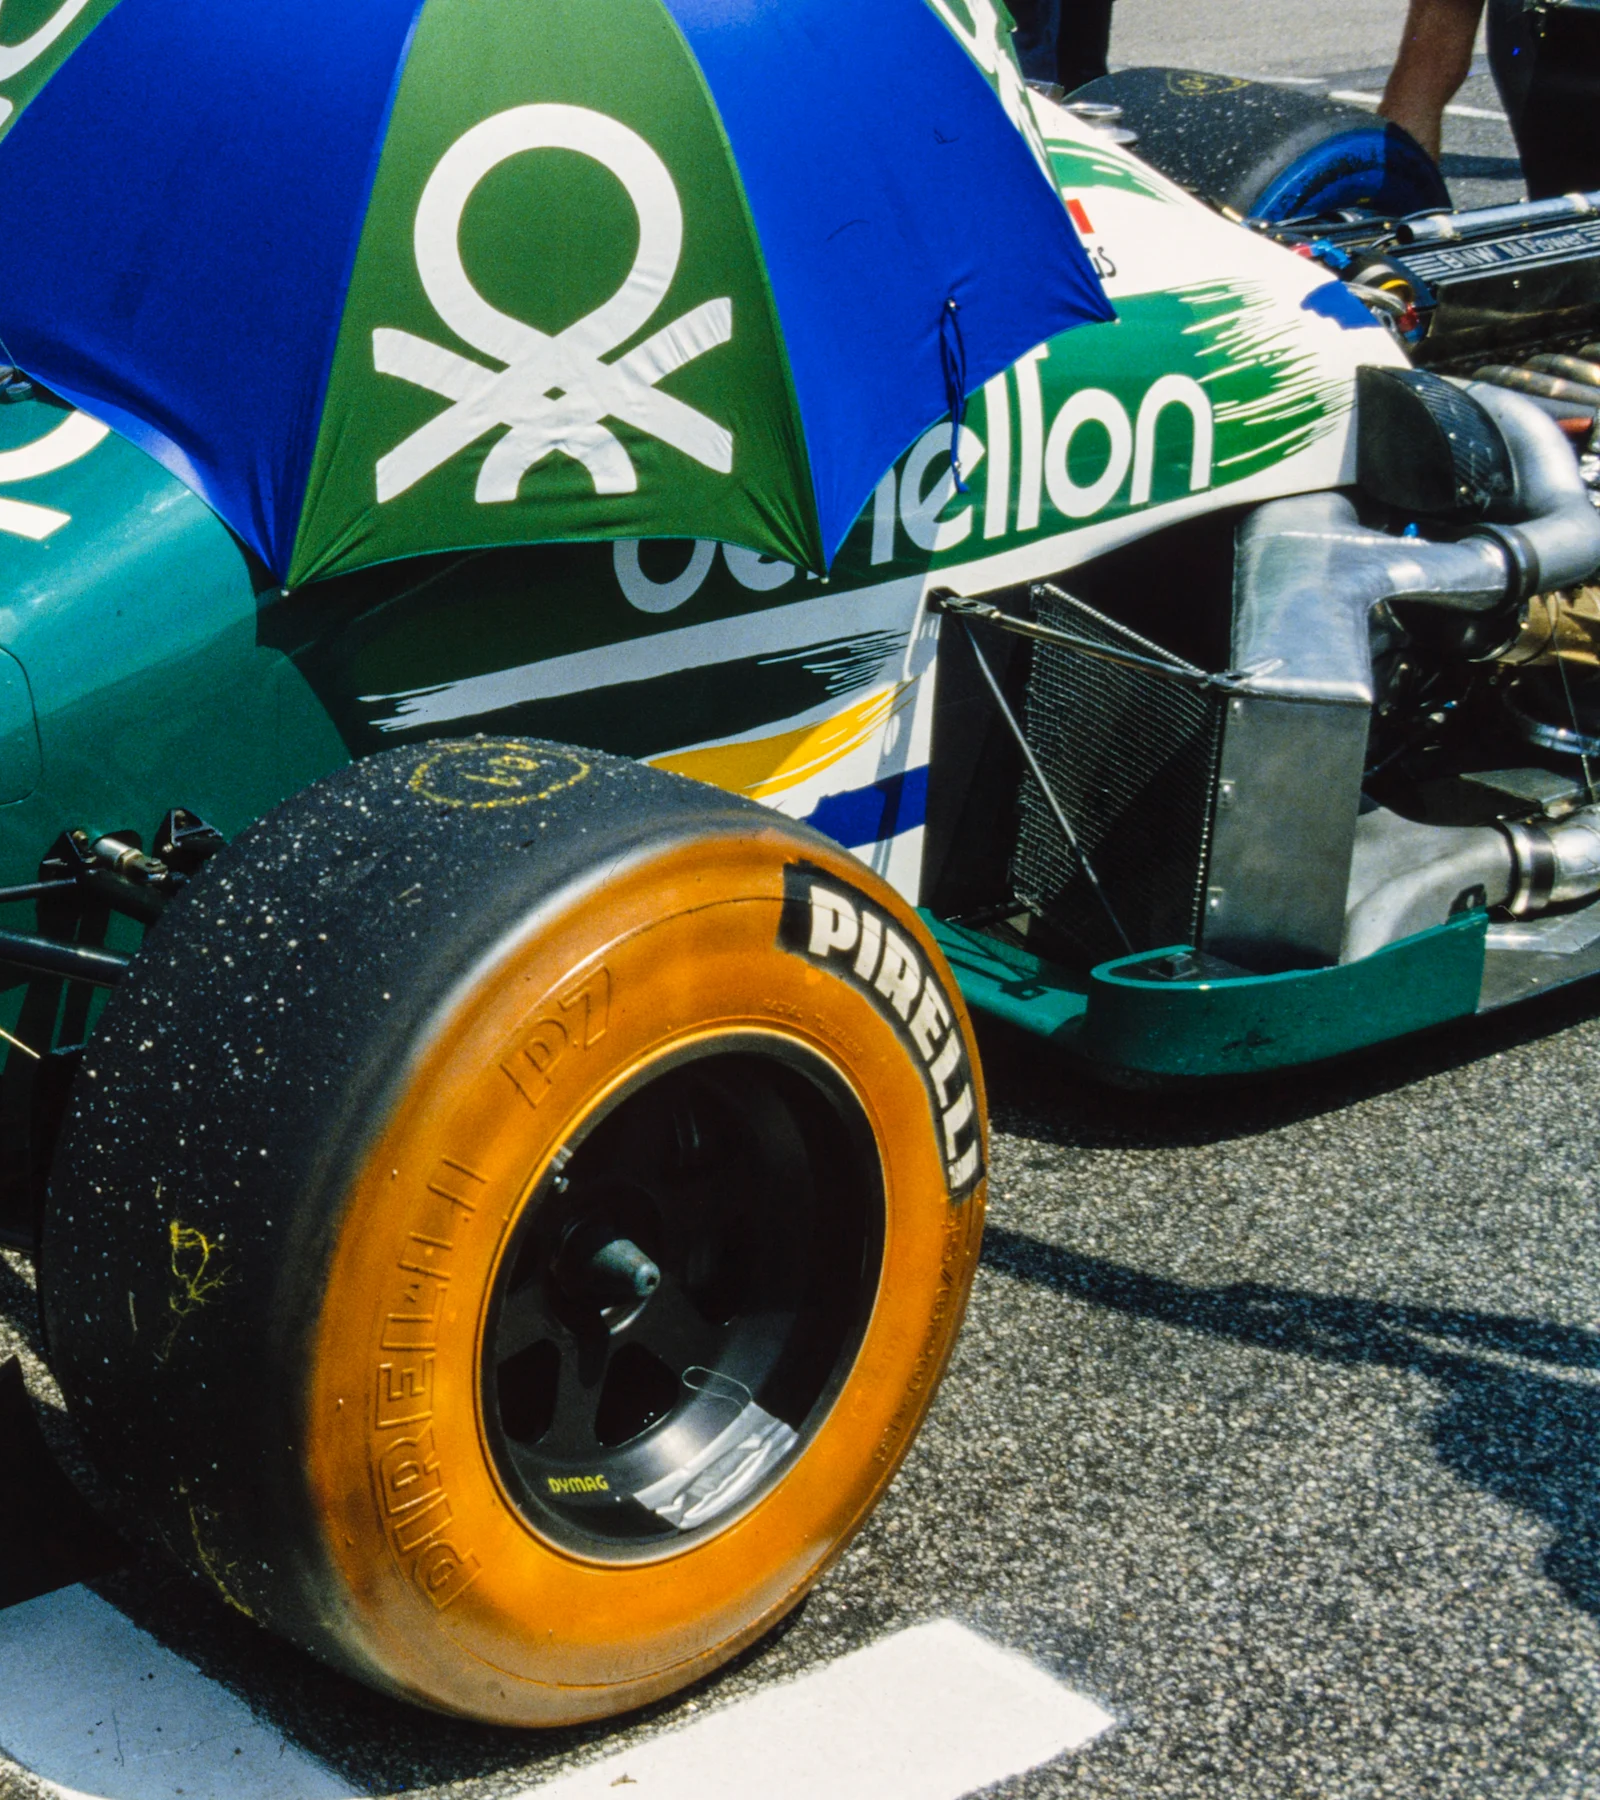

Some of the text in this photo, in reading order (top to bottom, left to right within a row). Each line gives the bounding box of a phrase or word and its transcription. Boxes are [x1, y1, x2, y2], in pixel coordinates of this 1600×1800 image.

[1437, 231, 1588, 271] BMW M Power
[499, 963, 611, 1109] P7
[807, 884, 980, 1190] PIRELLI
[375, 1156, 490, 1611] PIRELLI
[547, 1474, 609, 1493] DYMAG
